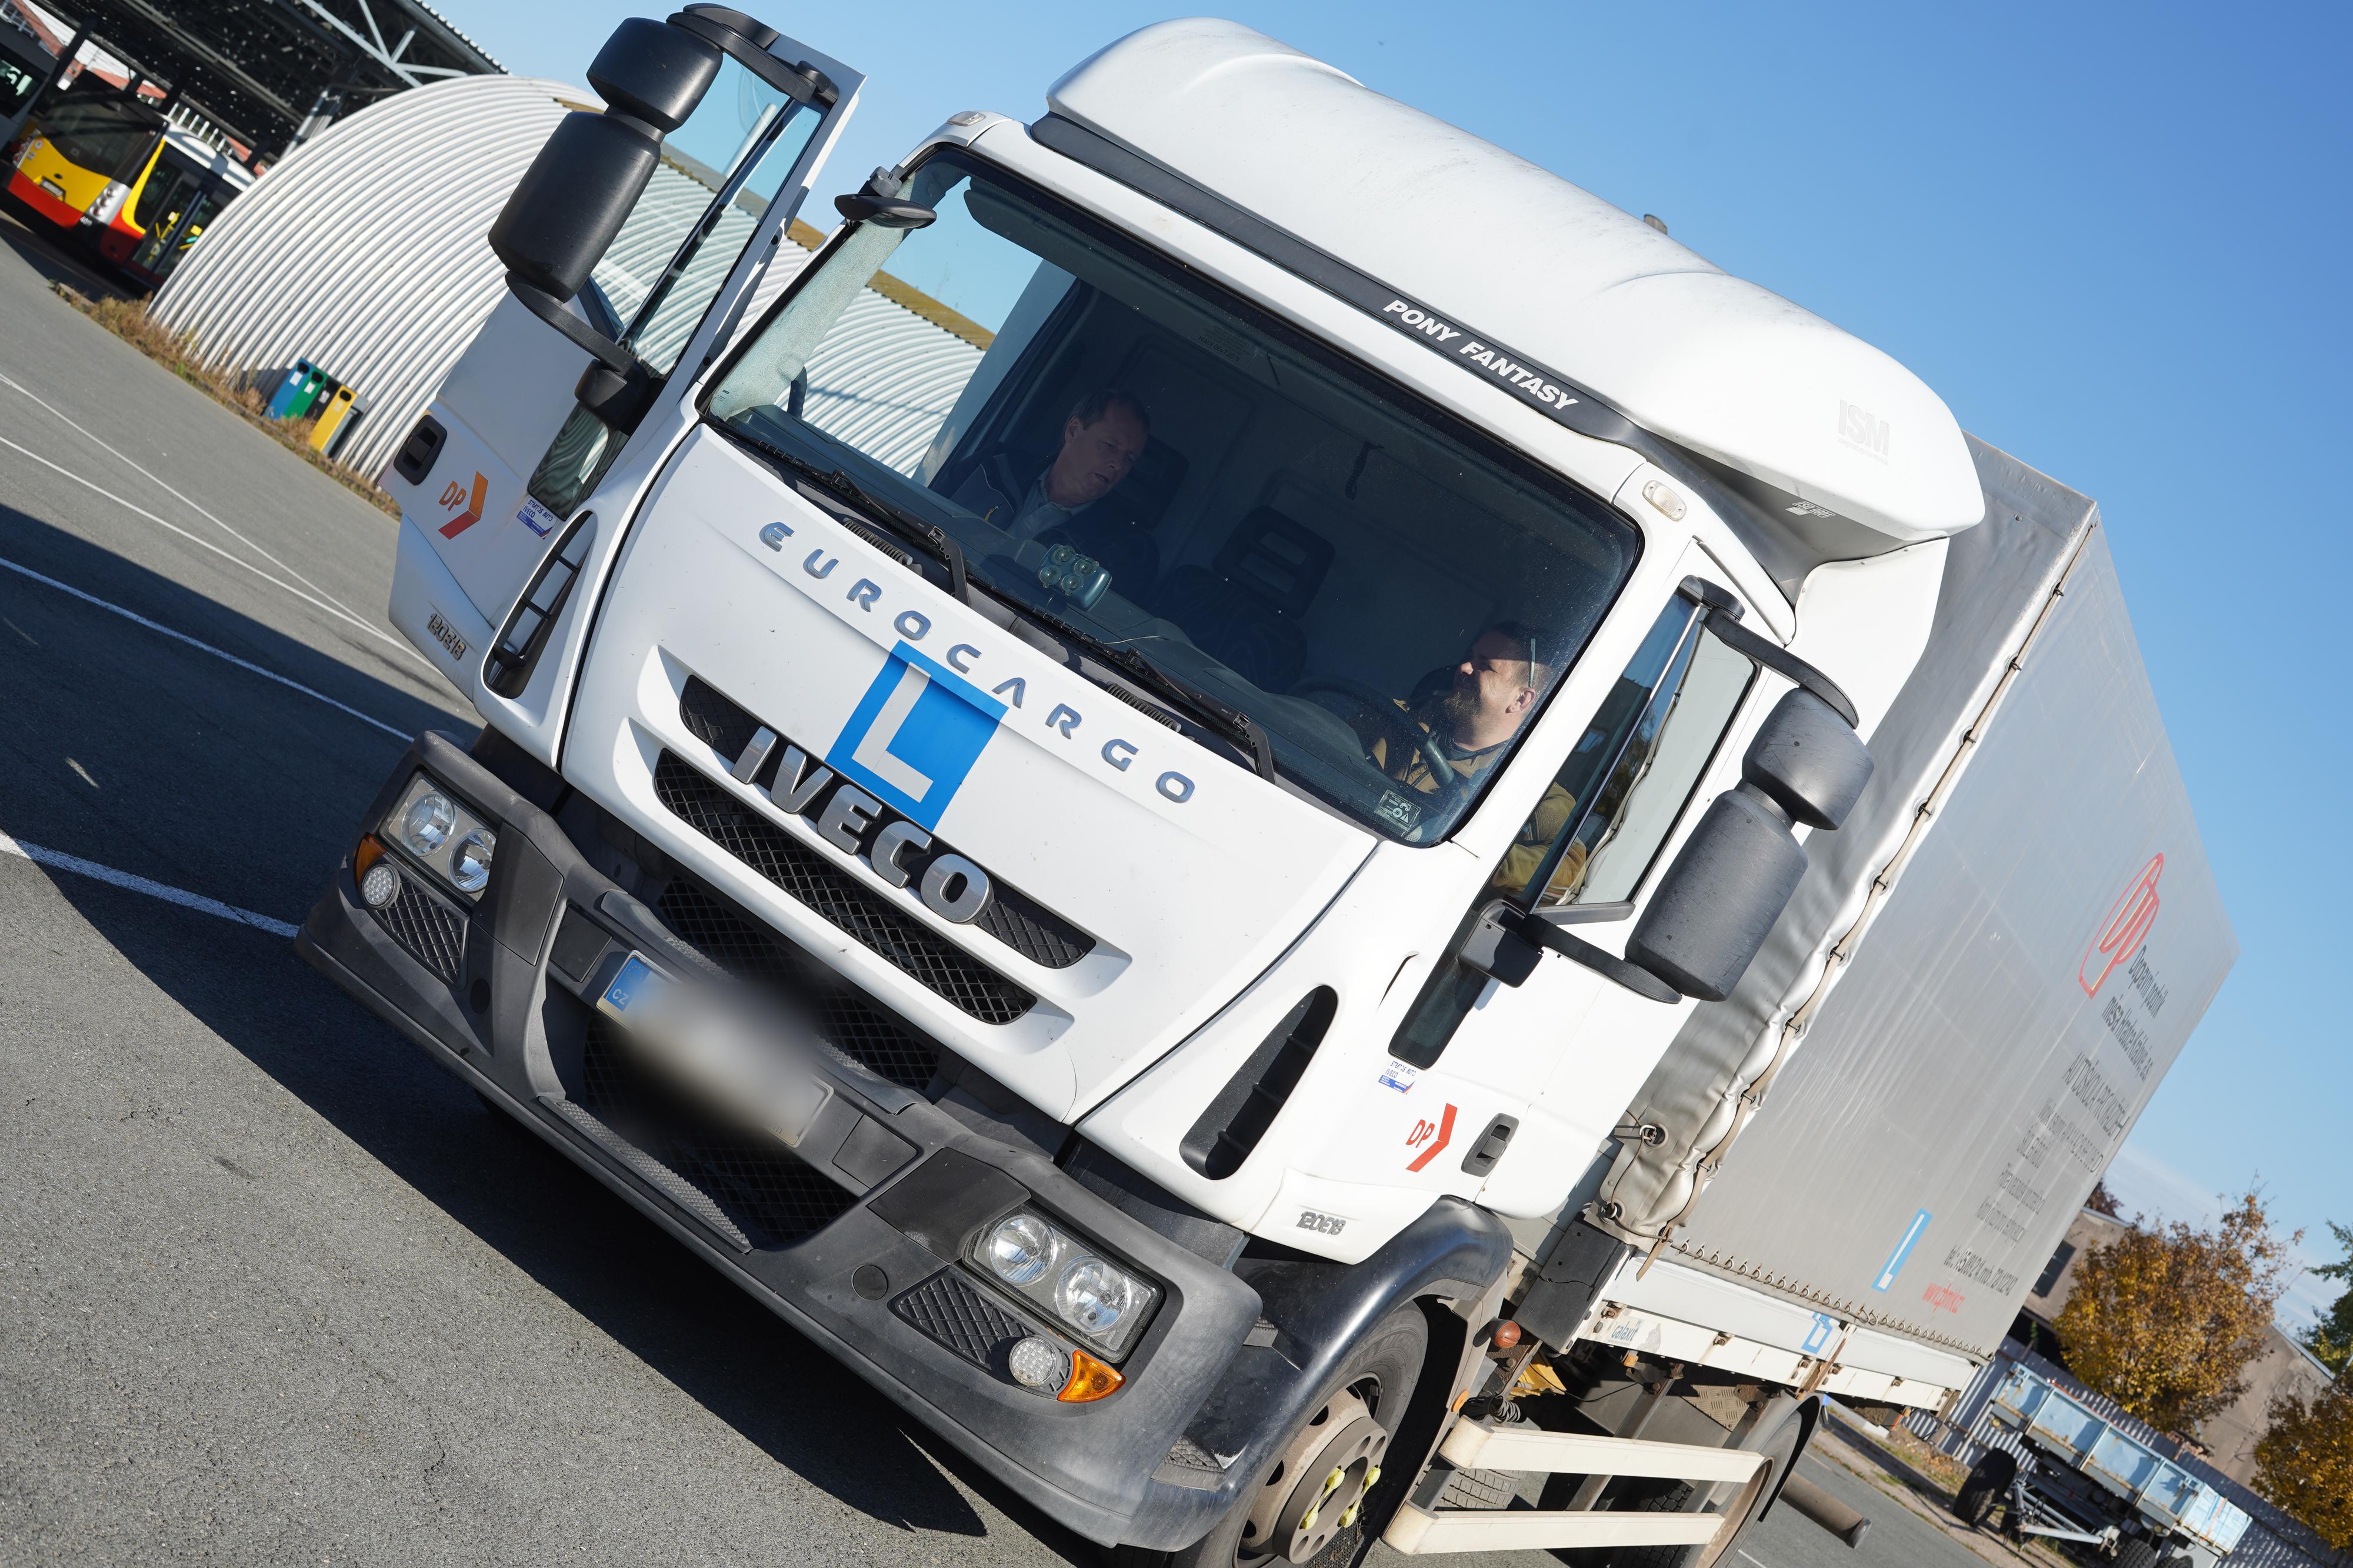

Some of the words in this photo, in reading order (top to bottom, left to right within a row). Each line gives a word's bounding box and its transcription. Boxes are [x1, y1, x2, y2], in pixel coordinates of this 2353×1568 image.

[1383, 299, 1461, 342] PONY
[1459, 341, 1579, 410] FANTASY
[1838, 399, 1889, 457] ISM
[439, 480, 466, 512] DP
[522, 505, 536, 518] IVECO
[759, 521, 1195, 803] EUROCARGO
[852, 662, 934, 803] L
[731, 726, 994, 925] IVECO
[2128, 944, 2159, 998] Dopavní
[612, 988, 629, 1005] CZ
[2102, 993, 2124, 1032] měsa
[1385, 1067, 1399, 1079] IVECO
[1405, 1119, 1435, 1149] DP
